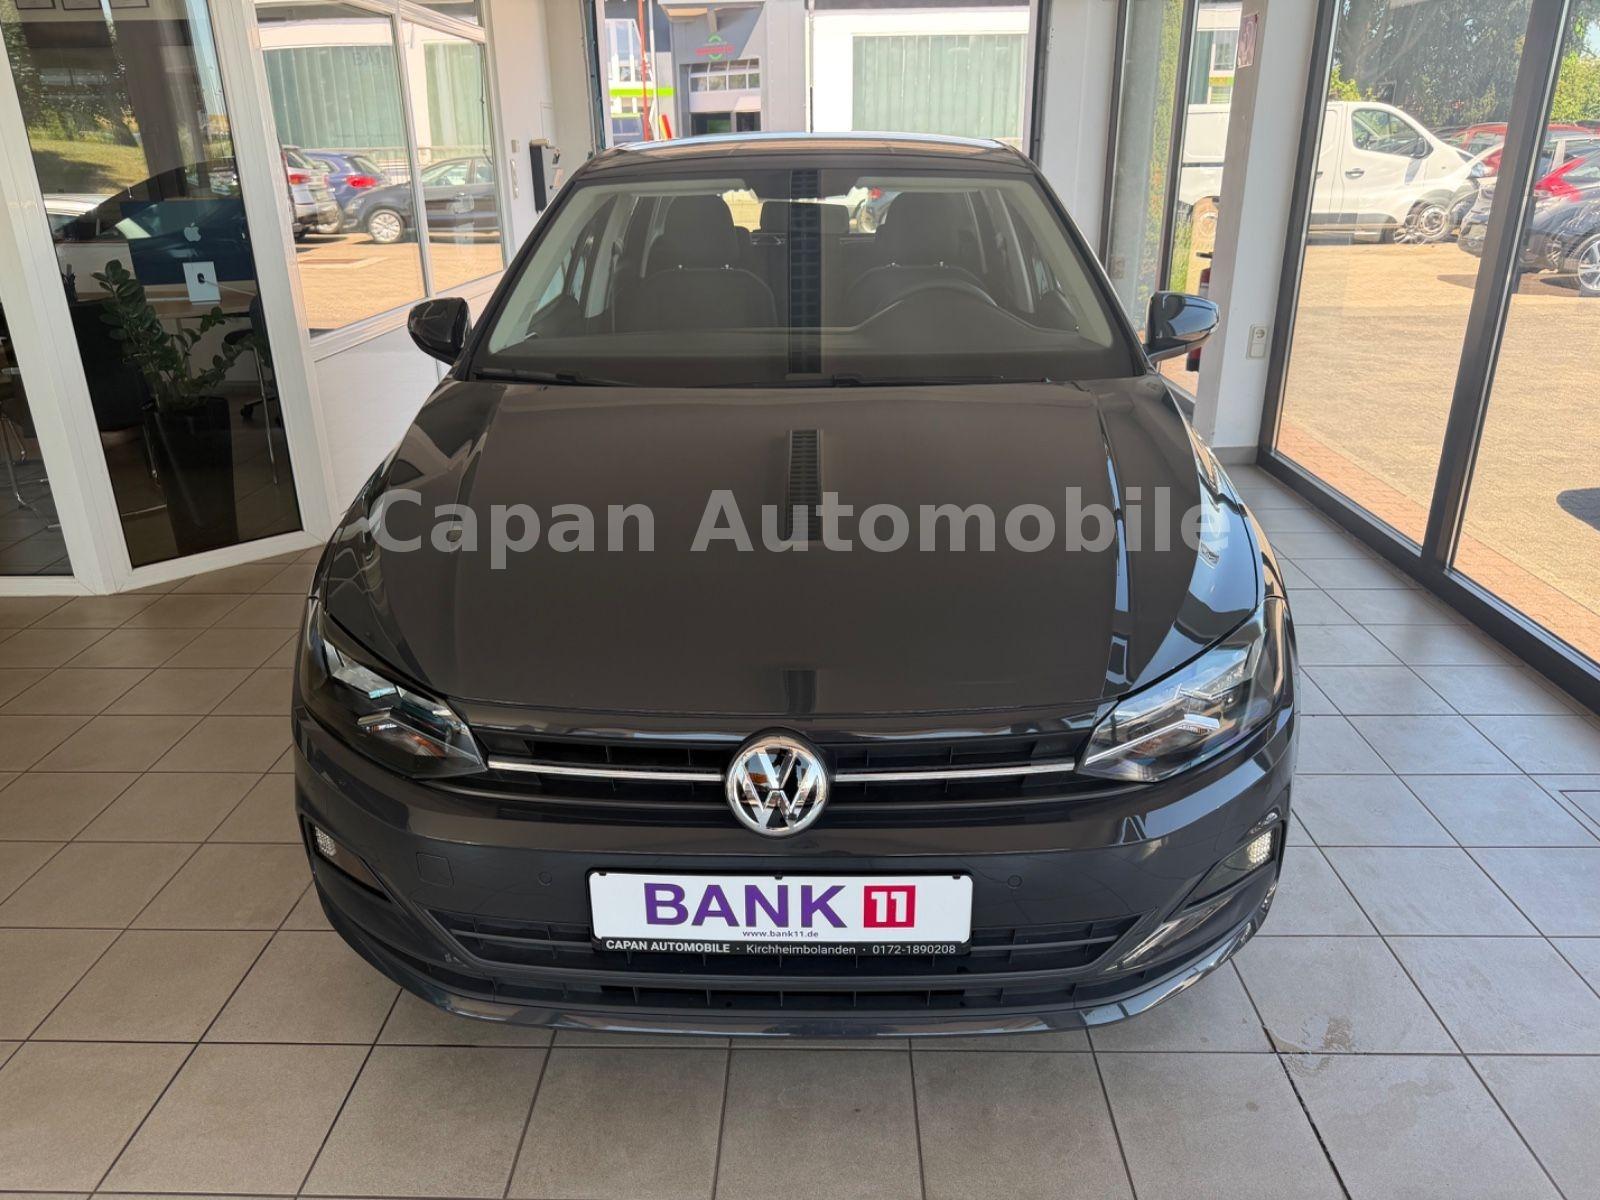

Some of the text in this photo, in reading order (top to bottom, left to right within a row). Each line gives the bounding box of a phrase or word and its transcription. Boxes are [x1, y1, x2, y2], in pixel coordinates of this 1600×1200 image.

[644, 883, 909, 928] BANK 11
[742, 930, 819, 938] www.bank11.de
[606, 939, 956, 955] CAPAN AUTOMOBILE Kirchheimbolanden 0172-1890208
